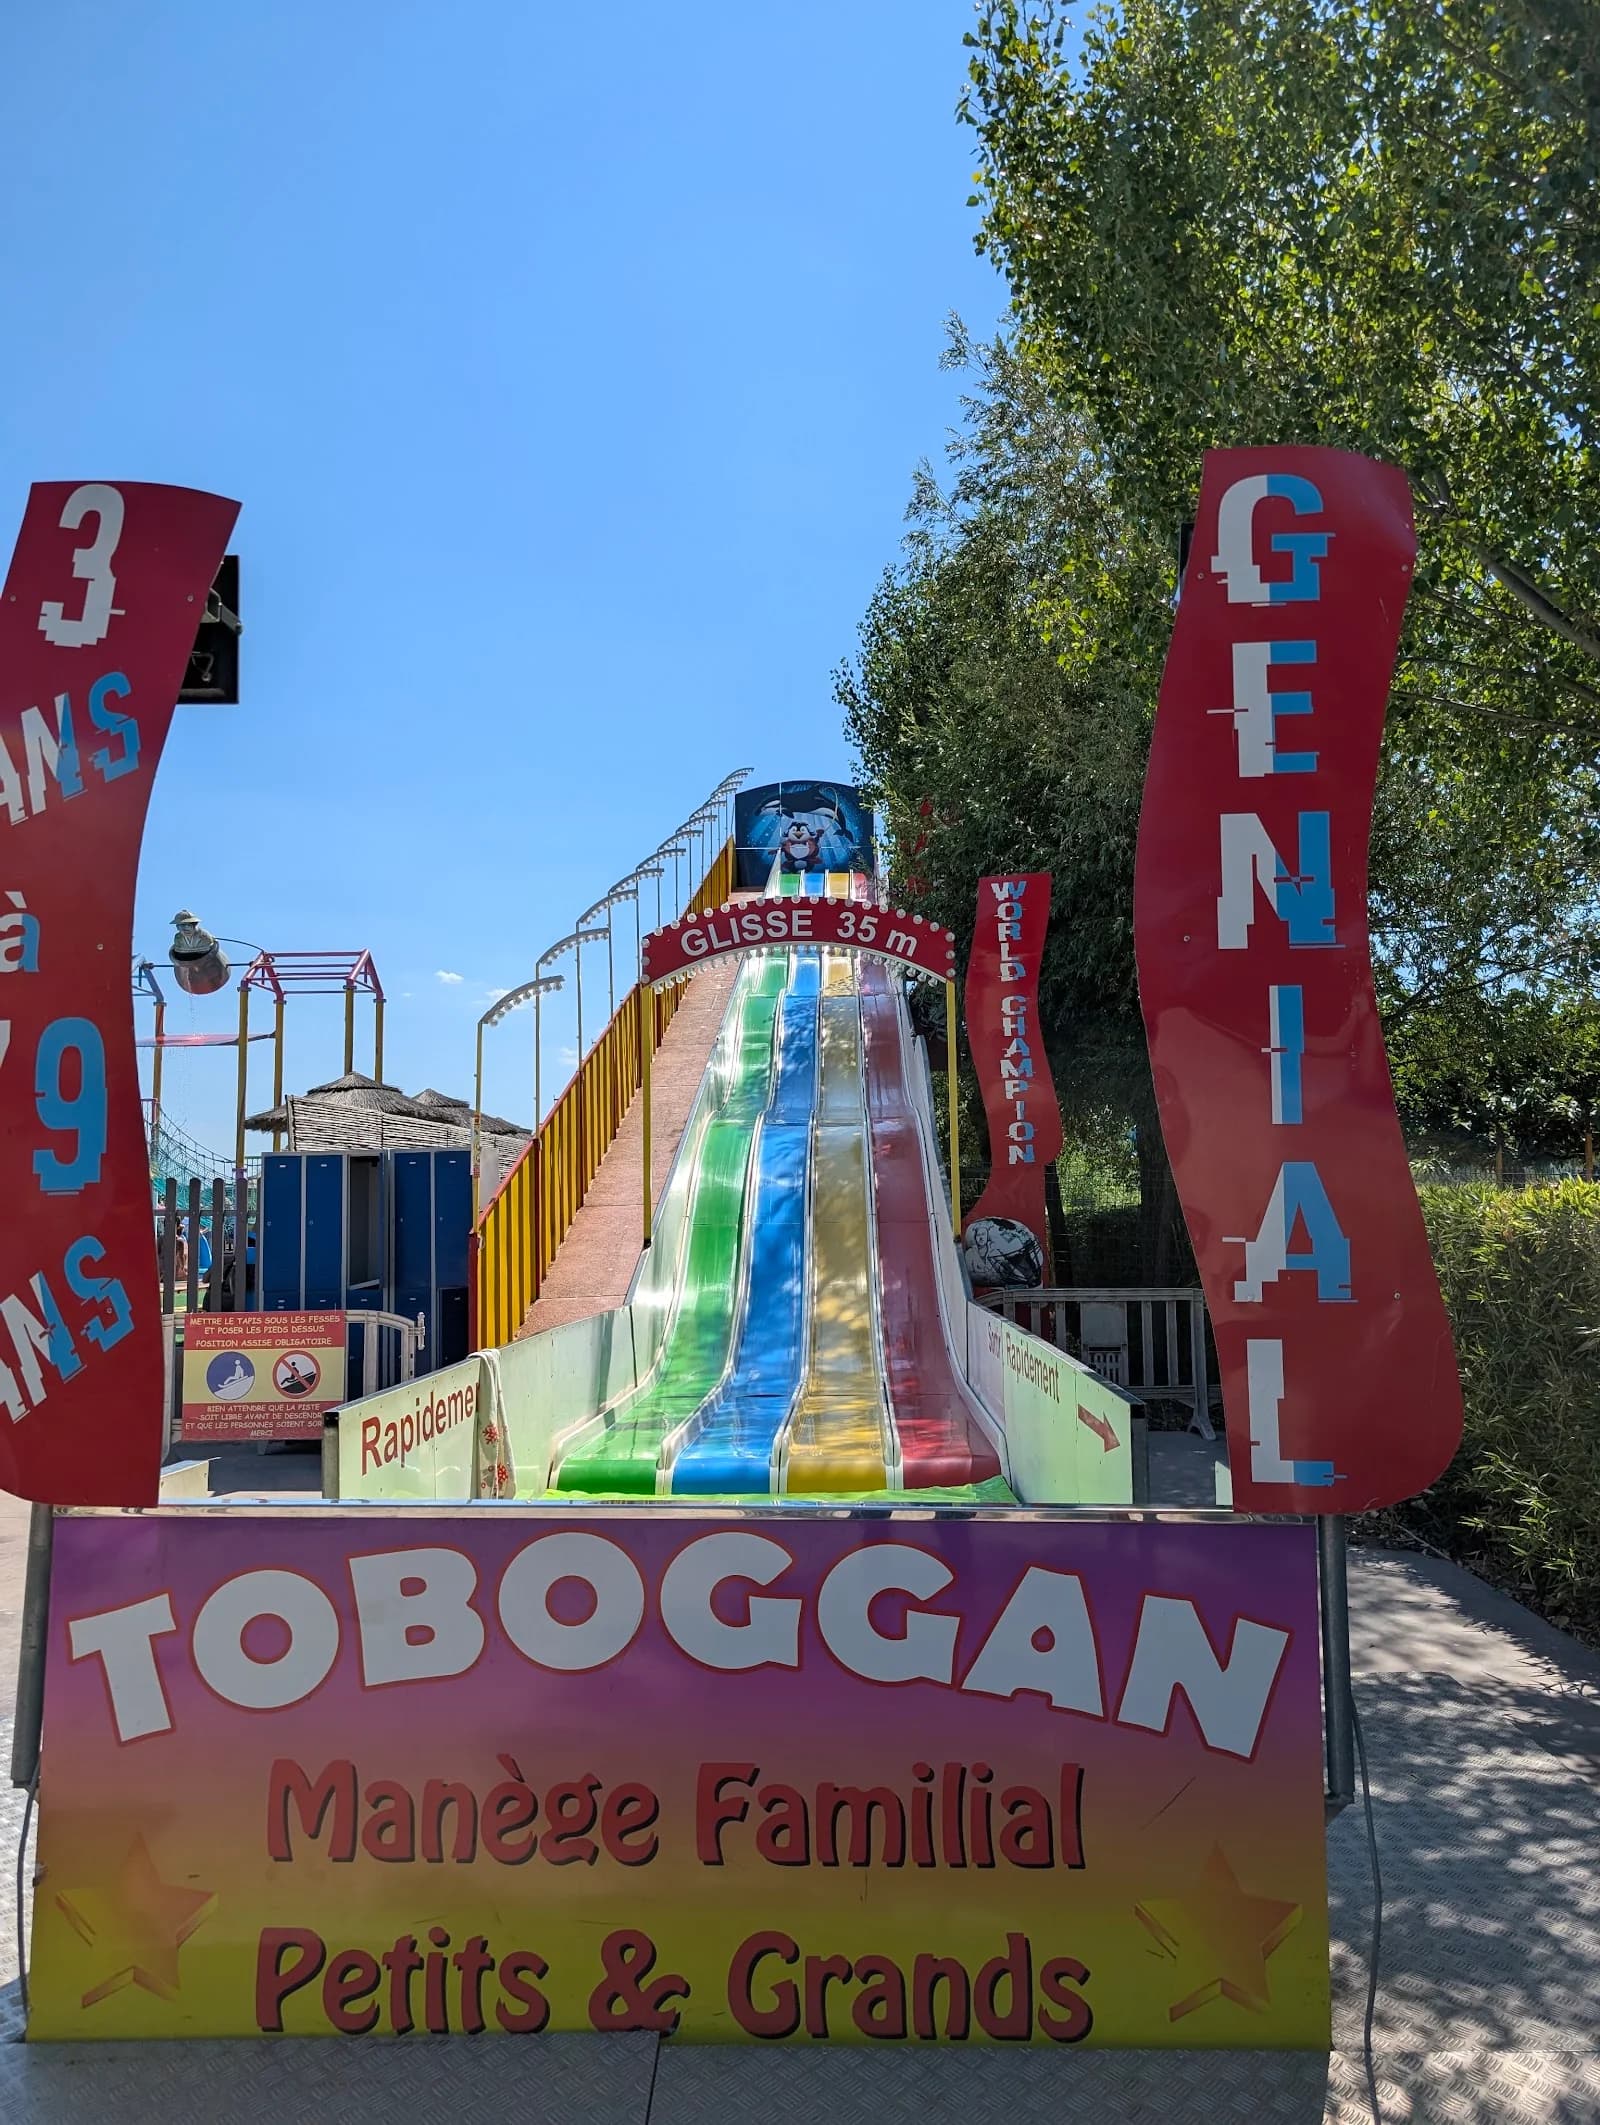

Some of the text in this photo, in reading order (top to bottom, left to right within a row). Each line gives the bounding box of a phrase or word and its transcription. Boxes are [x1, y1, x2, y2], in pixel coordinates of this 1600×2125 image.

[38, 484, 125, 648] 3
[680, 909, 918, 957] GLISSE 35 m
[1207, 473, 1358, 1484] GENIAL
[991, 880, 1037, 1165] WORLD CHAMPION
[0, 1017, 107, 1195] 9
[190, 1315, 340, 1326] METTRE LE TAPIS SOUS LES FESSES
[196, 1337, 332, 1347] POSITION ASSISE OBLIGATOIRE
[204, 1325, 325, 1335] ET POSER LES PIEDS DESSUS
[1006, 1331, 1060, 1404] Rapidement
[197, 1422, 213, 1430] QUE
[214, 1422, 229, 1430] LES
[230, 1421, 274, 1429] PERSONNES
[276, 1421, 306, 1429] SOIENT
[307, 1420, 322, 1428] SOR
[207, 1405, 226, 1413] BIEN
[268, 1404, 284, 1412] QUE
[221, 1413, 242, 1421] LIBRE
[284, 1412, 322, 1420] DESCENDR
[249, 1429, 274, 1437] MERCI
[67, 1531, 1292, 1762] TOBOGGAN
[267, 1753, 1087, 1870] Manège Familial
[253, 1925, 1094, 2042] Petits & Grands
